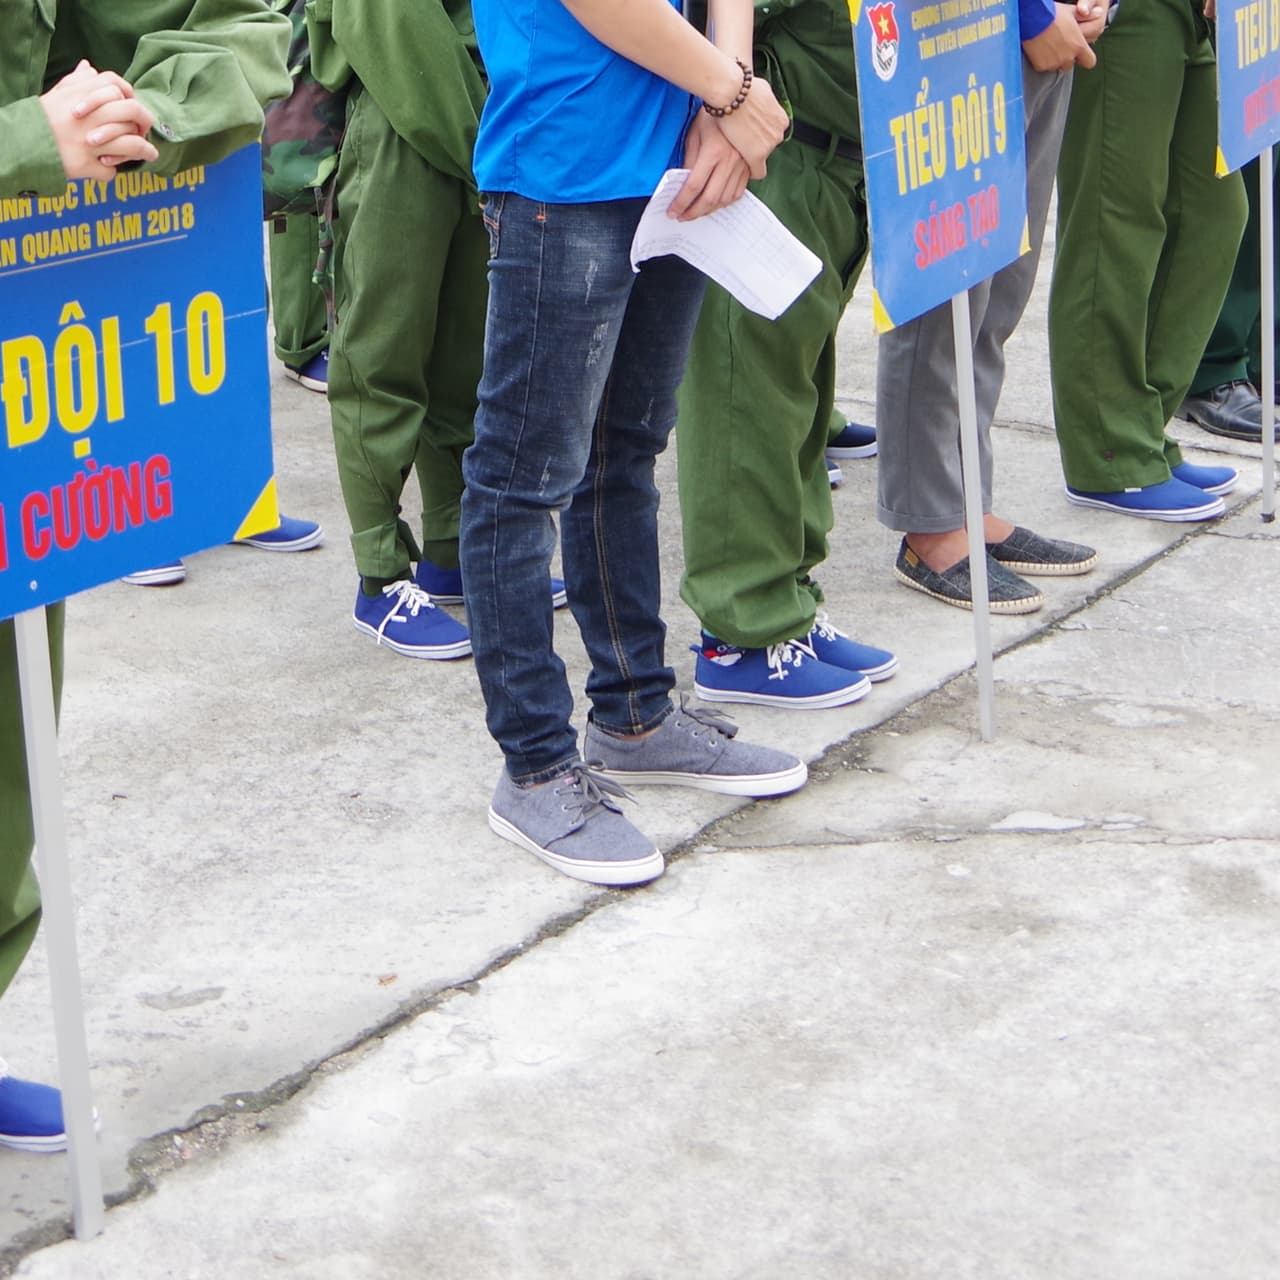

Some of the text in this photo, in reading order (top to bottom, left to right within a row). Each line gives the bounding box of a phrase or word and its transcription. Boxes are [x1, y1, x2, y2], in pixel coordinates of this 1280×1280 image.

[889, 72, 1007, 196] TIỂU ĐỘI 9
[22, 223, 91, 264] QUANG
[97, 211, 142, 247] NĂM
[147, 203, 195, 237] 2018
[914, 184, 999, 270] SÁNG TẠO
[0, 300, 125, 459] ĐỘI
[144, 291, 226, 406] 10
[21, 454, 173, 560] CƯỜNG
